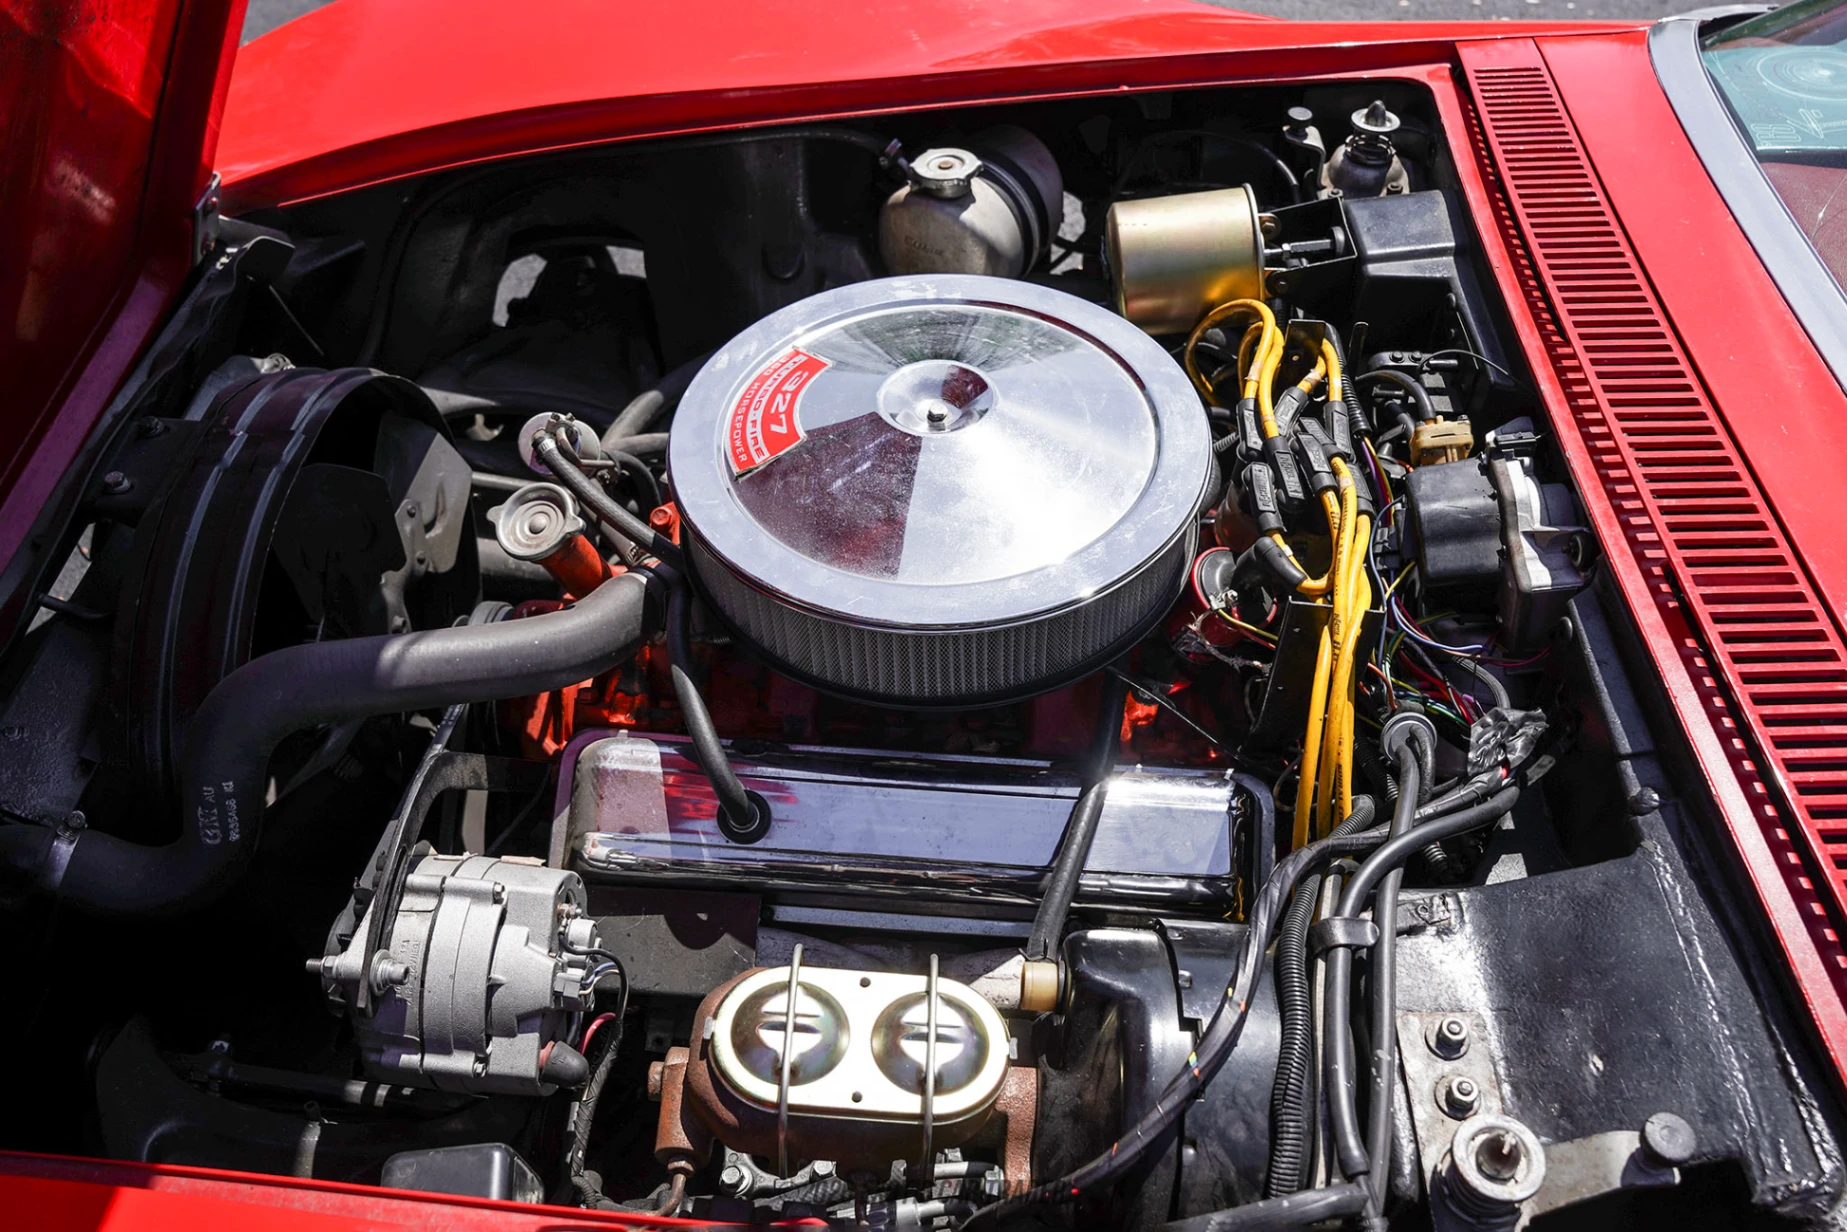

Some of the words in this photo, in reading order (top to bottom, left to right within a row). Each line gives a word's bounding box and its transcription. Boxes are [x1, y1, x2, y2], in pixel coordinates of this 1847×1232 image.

[733, 382, 761, 463] HORSEPOWER
[750, 357, 804, 460] TURBO-FIRE
[769, 370, 809, 435] 327
